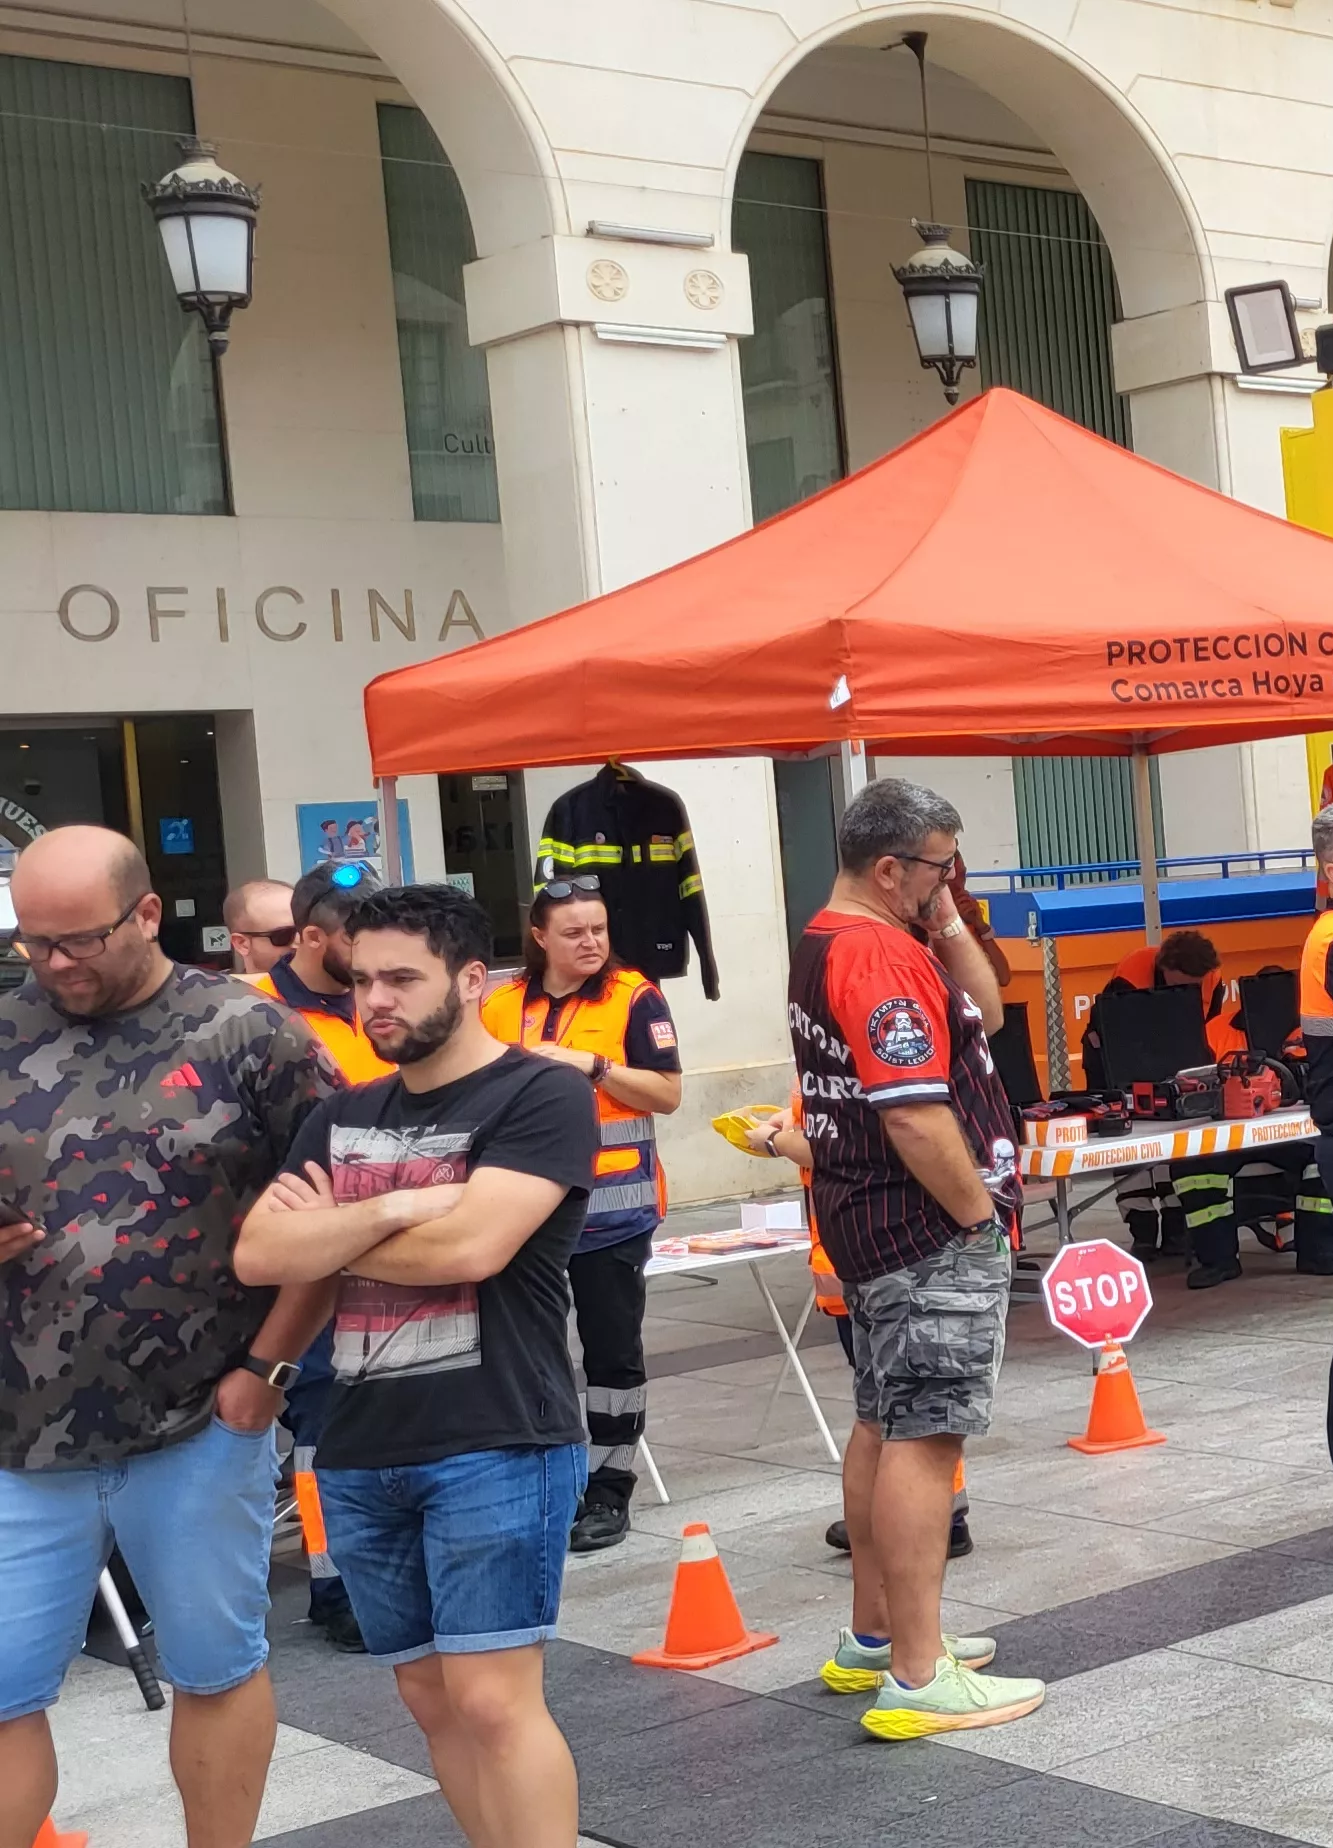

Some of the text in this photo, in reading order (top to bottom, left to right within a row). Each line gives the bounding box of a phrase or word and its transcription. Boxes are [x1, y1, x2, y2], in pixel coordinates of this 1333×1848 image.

[58, 584, 486, 643] OFICINA
[1106, 632, 1308, 667] PROTECCION
[1110, 676, 1244, 703] Comarca
[1252, 671, 1324, 698] Hoya
[1251, 1121, 1303, 1143] PROTECCION
[1081, 1141, 1164, 1169] PROTECCION CIVIL
[1055, 1270, 1139, 1316] STOP
